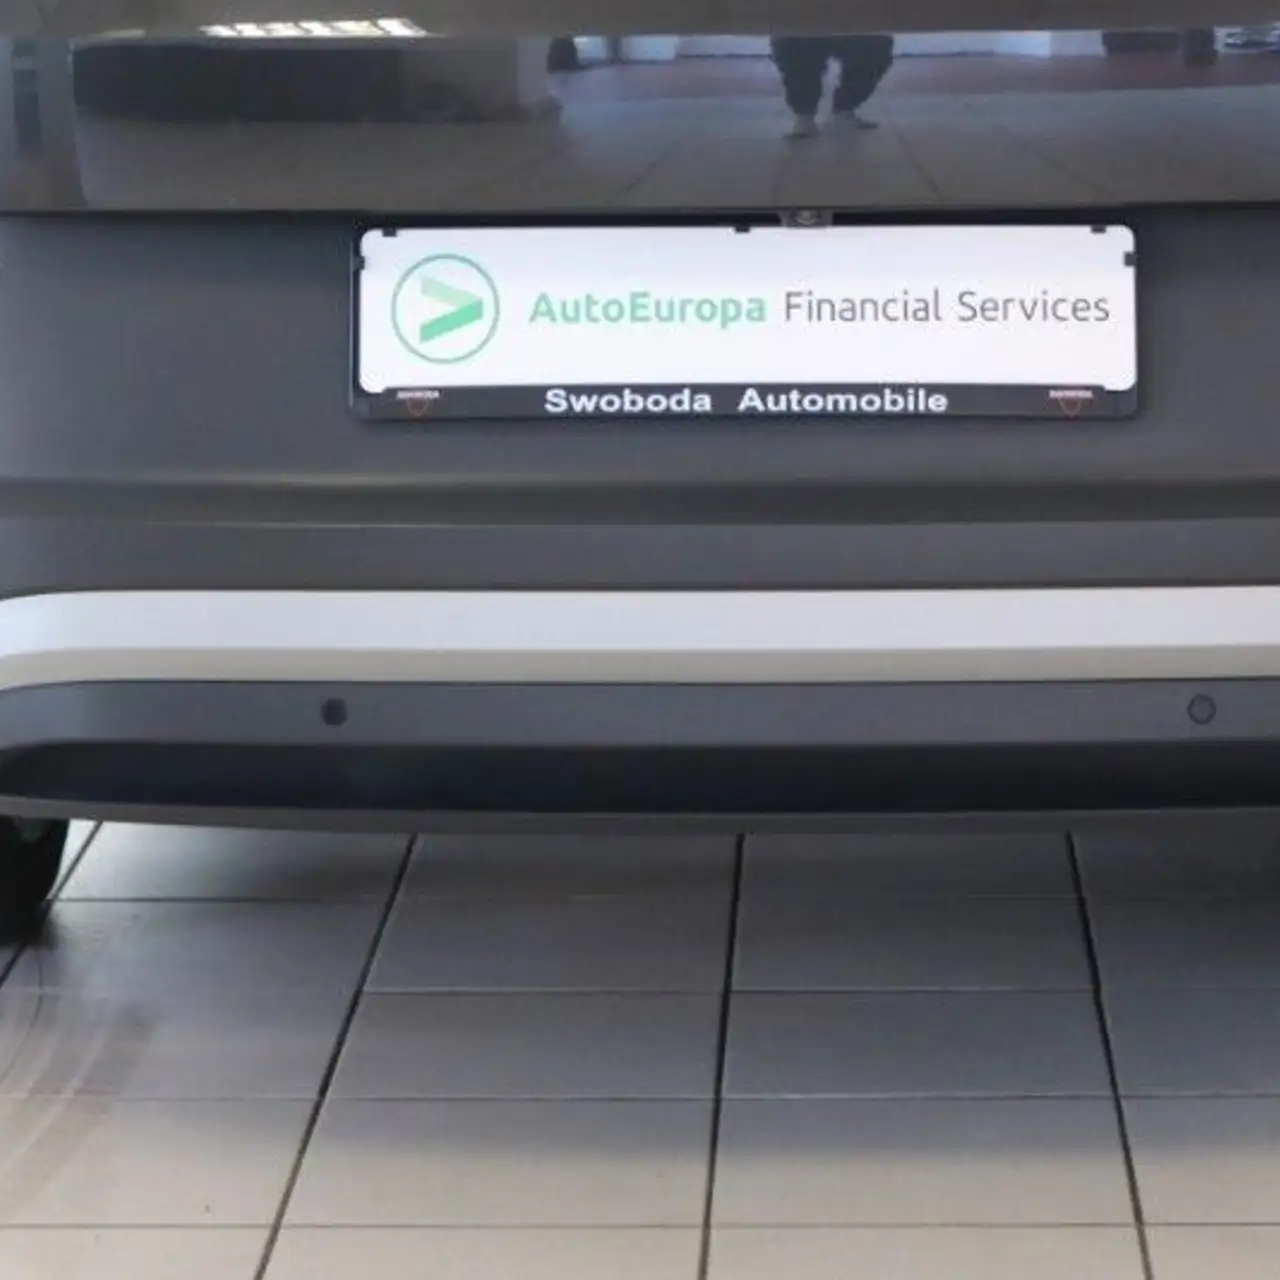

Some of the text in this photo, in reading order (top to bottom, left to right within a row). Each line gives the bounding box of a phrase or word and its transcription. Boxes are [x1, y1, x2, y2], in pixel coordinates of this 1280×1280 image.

[529, 289, 1111, 329] AutoEuropa Financial Services
[544, 386, 949, 413] Swoboda Automobile
